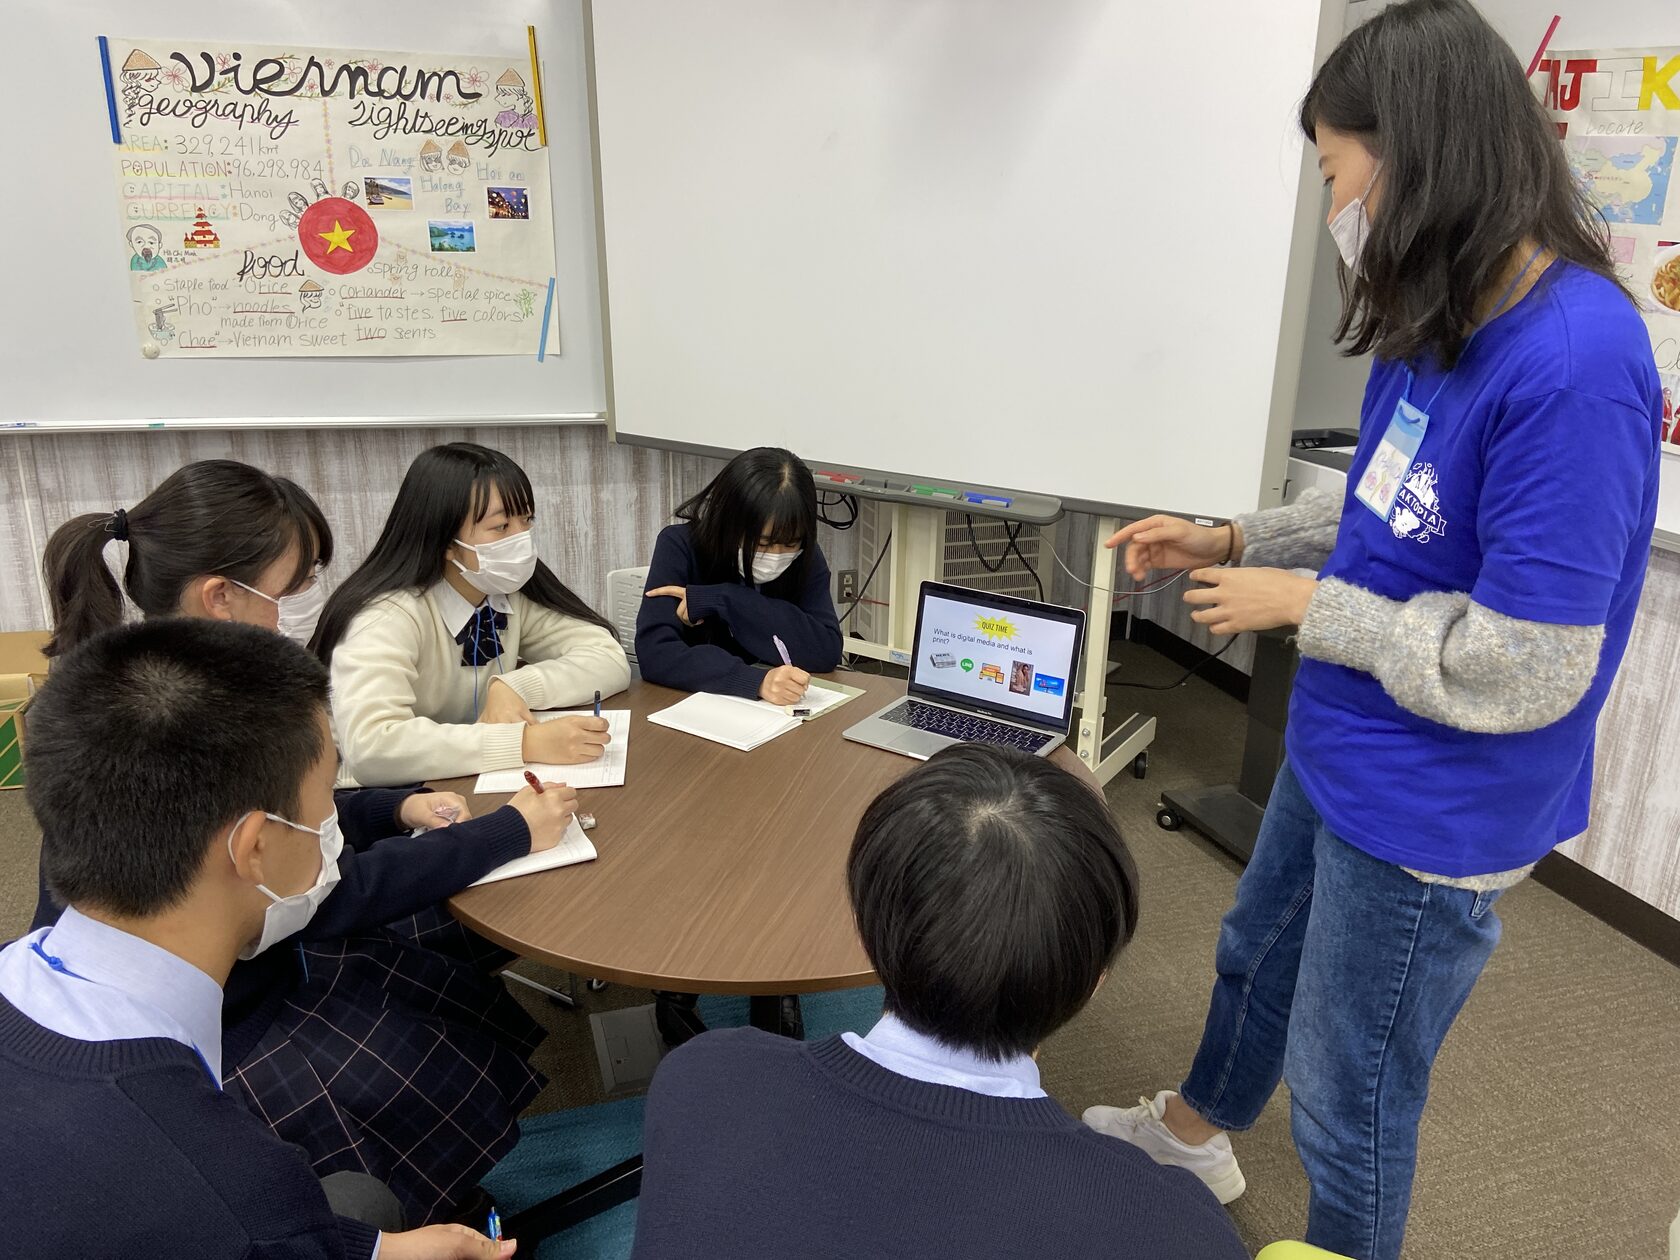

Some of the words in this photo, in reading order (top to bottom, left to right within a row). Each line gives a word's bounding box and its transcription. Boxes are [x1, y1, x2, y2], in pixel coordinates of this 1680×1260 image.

[229, 181, 273, 199] Hanoi
[240, 202, 279, 232] Dong
[237, 250, 304, 282] food
[209, 279, 229, 292] food
[233, 298, 292, 313] noodles
[220, 316, 253, 328] made
[259, 315, 282, 327] from
[233, 331, 292, 347] Vietnam
[1398, 488, 1436, 526] AKTOPIA
[981, 621, 995, 631] QUIZ
[995, 624, 1008, 634] TIME
[932, 637, 950, 645] print?
[933, 628, 950, 637] What
[957, 633, 975, 643] digital
[976, 638, 995, 648] media
[997, 642, 1009, 650] and
[1010, 645, 1026, 654] what
